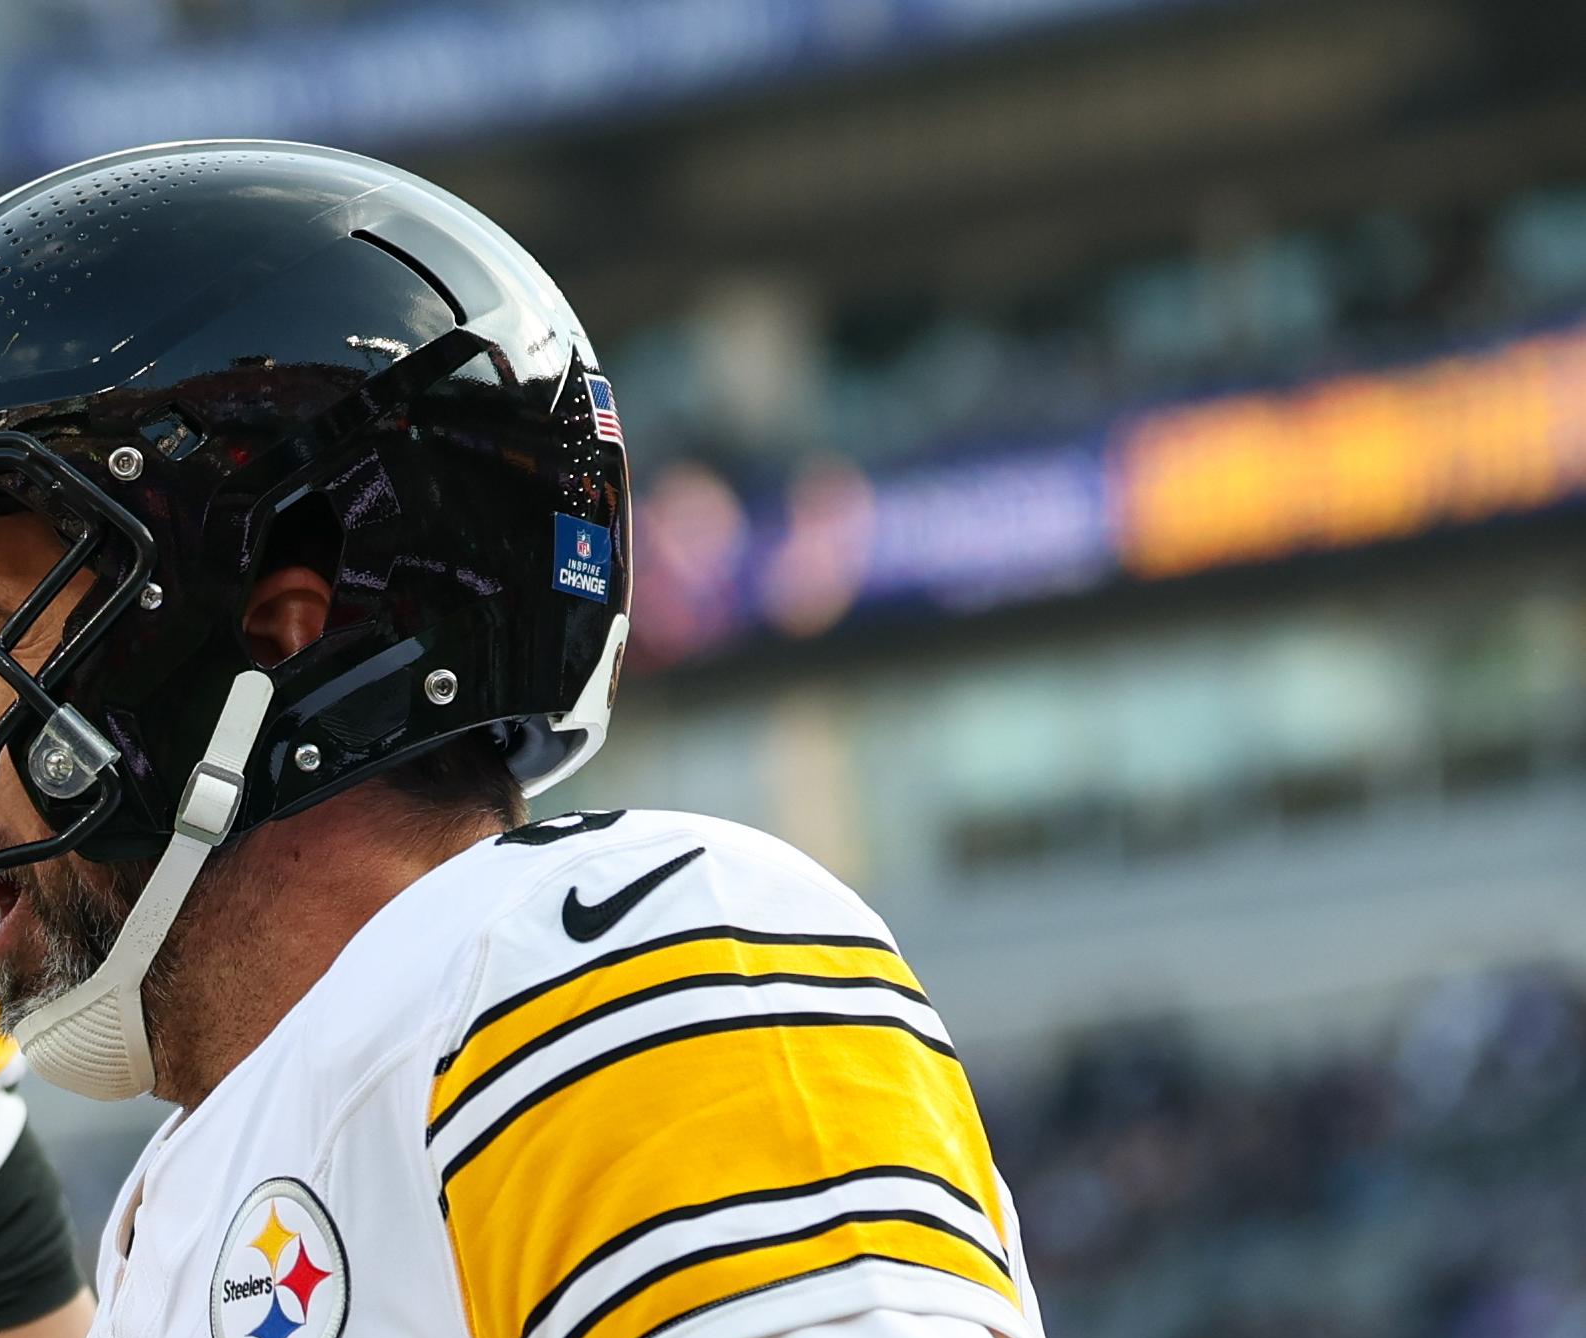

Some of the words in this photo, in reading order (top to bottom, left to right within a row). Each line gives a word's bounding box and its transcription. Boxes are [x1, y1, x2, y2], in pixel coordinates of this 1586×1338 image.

[568, 558, 602, 577] INSPIRE
[559, 568, 607, 595] CHANGE
[223, 1274, 273, 1304] Steelers
